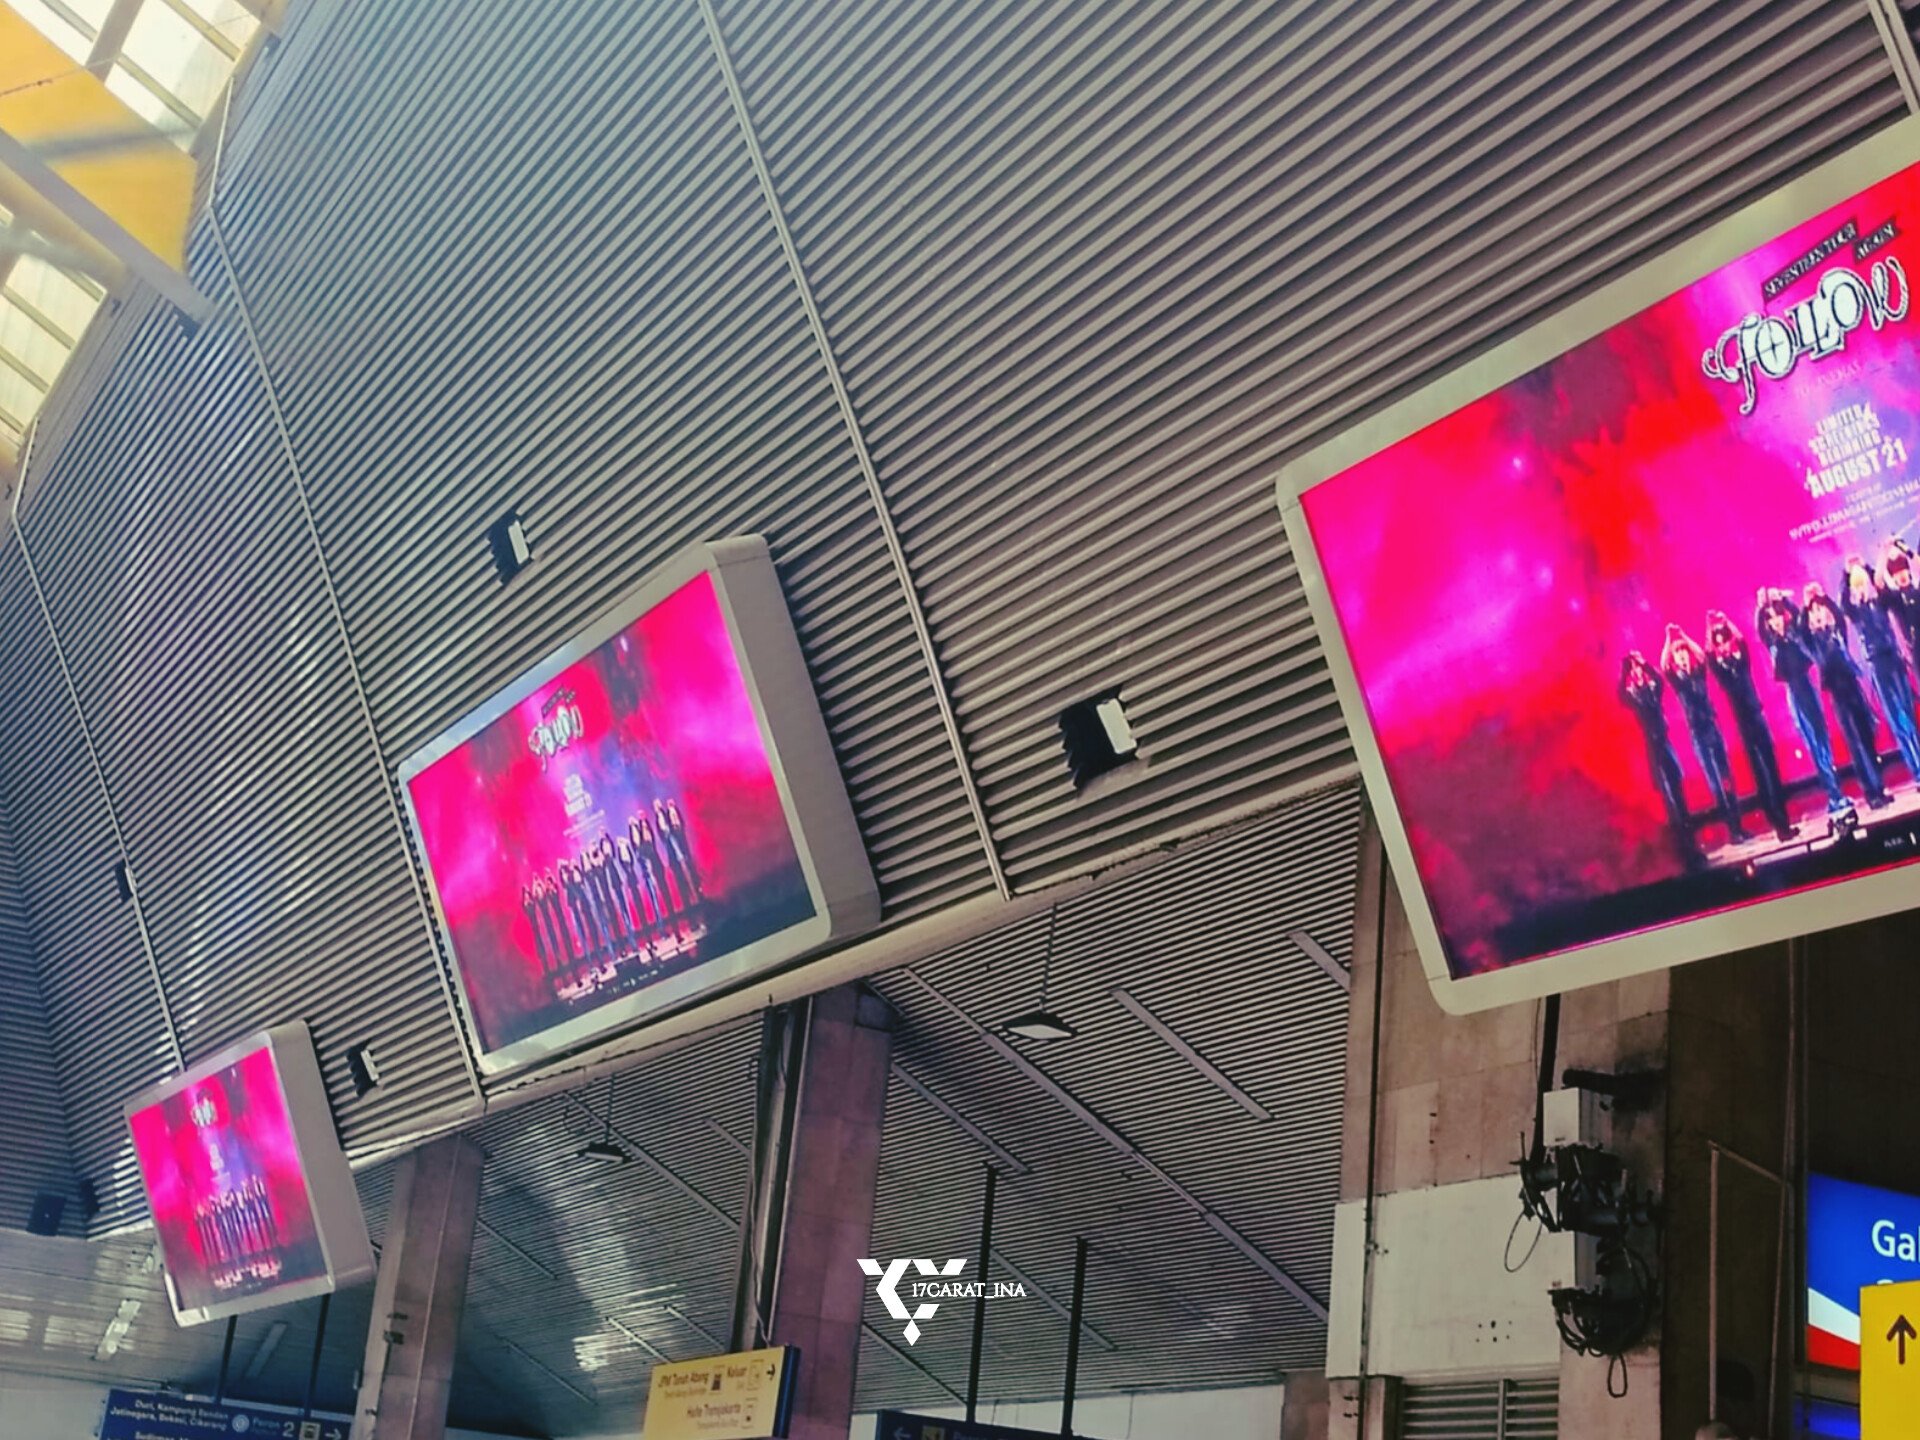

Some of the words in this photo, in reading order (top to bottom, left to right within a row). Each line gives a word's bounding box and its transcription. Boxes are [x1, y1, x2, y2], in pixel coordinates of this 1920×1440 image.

[1808, 449, 1880, 499] AUGUST
[1881, 438, 1908, 467] 21
[282, 1421, 295, 1438] 2
